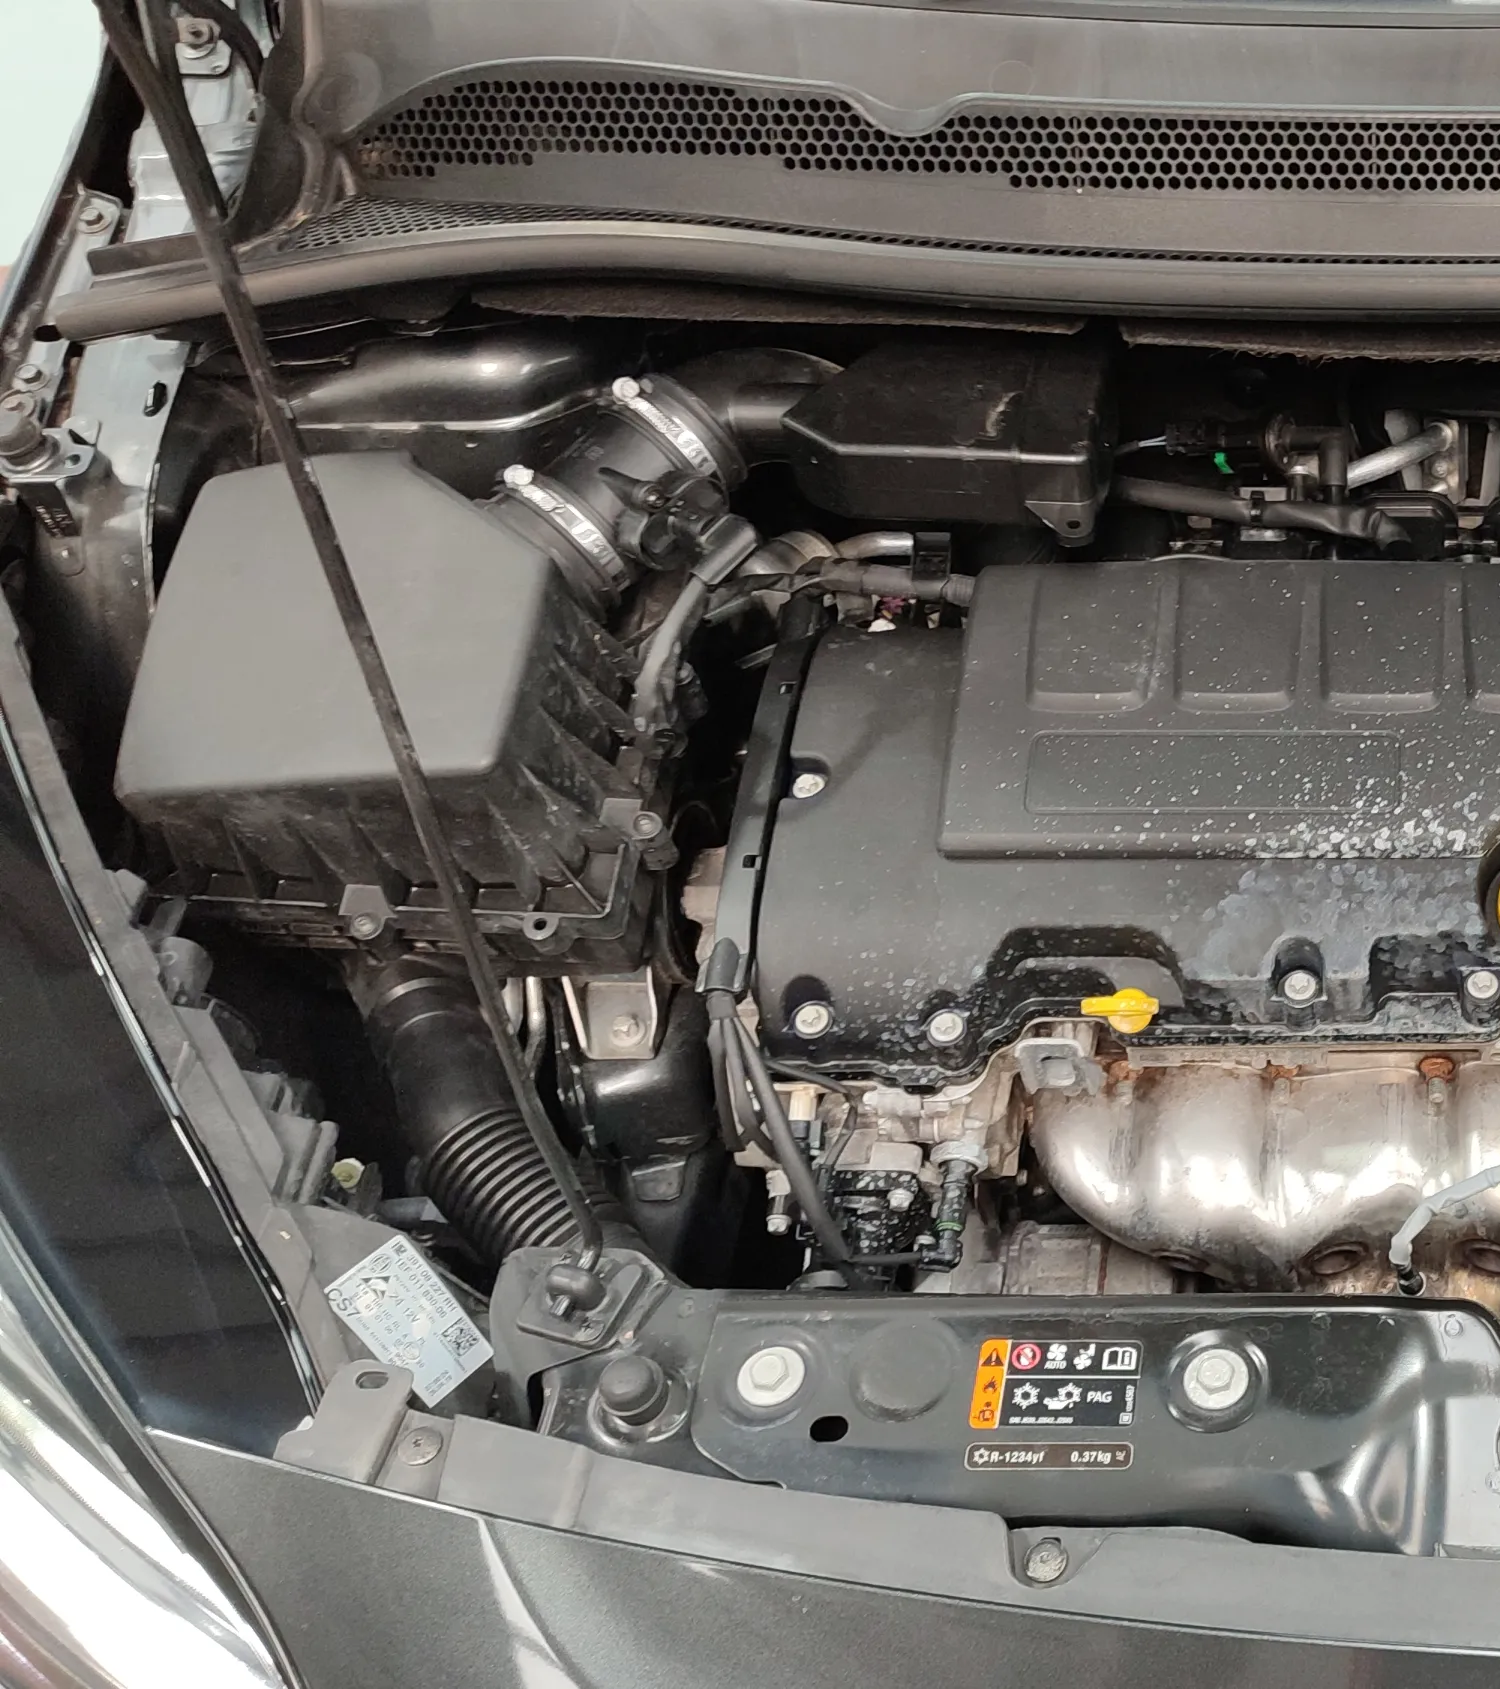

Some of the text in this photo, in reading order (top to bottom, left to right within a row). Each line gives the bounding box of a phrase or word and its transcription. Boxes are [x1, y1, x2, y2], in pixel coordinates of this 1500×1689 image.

[408, 1272, 424, 1290] 011
[429, 1280, 445, 1298] 227
[326, 1288, 361, 1318] CS7
[402, 1307, 419, 1324] 12V
[1043, 1360, 1067, 1370] AUTO
[1086, 1391, 1113, 1403] PAG
[990, 1450, 1045, 1465] R-1234yf
